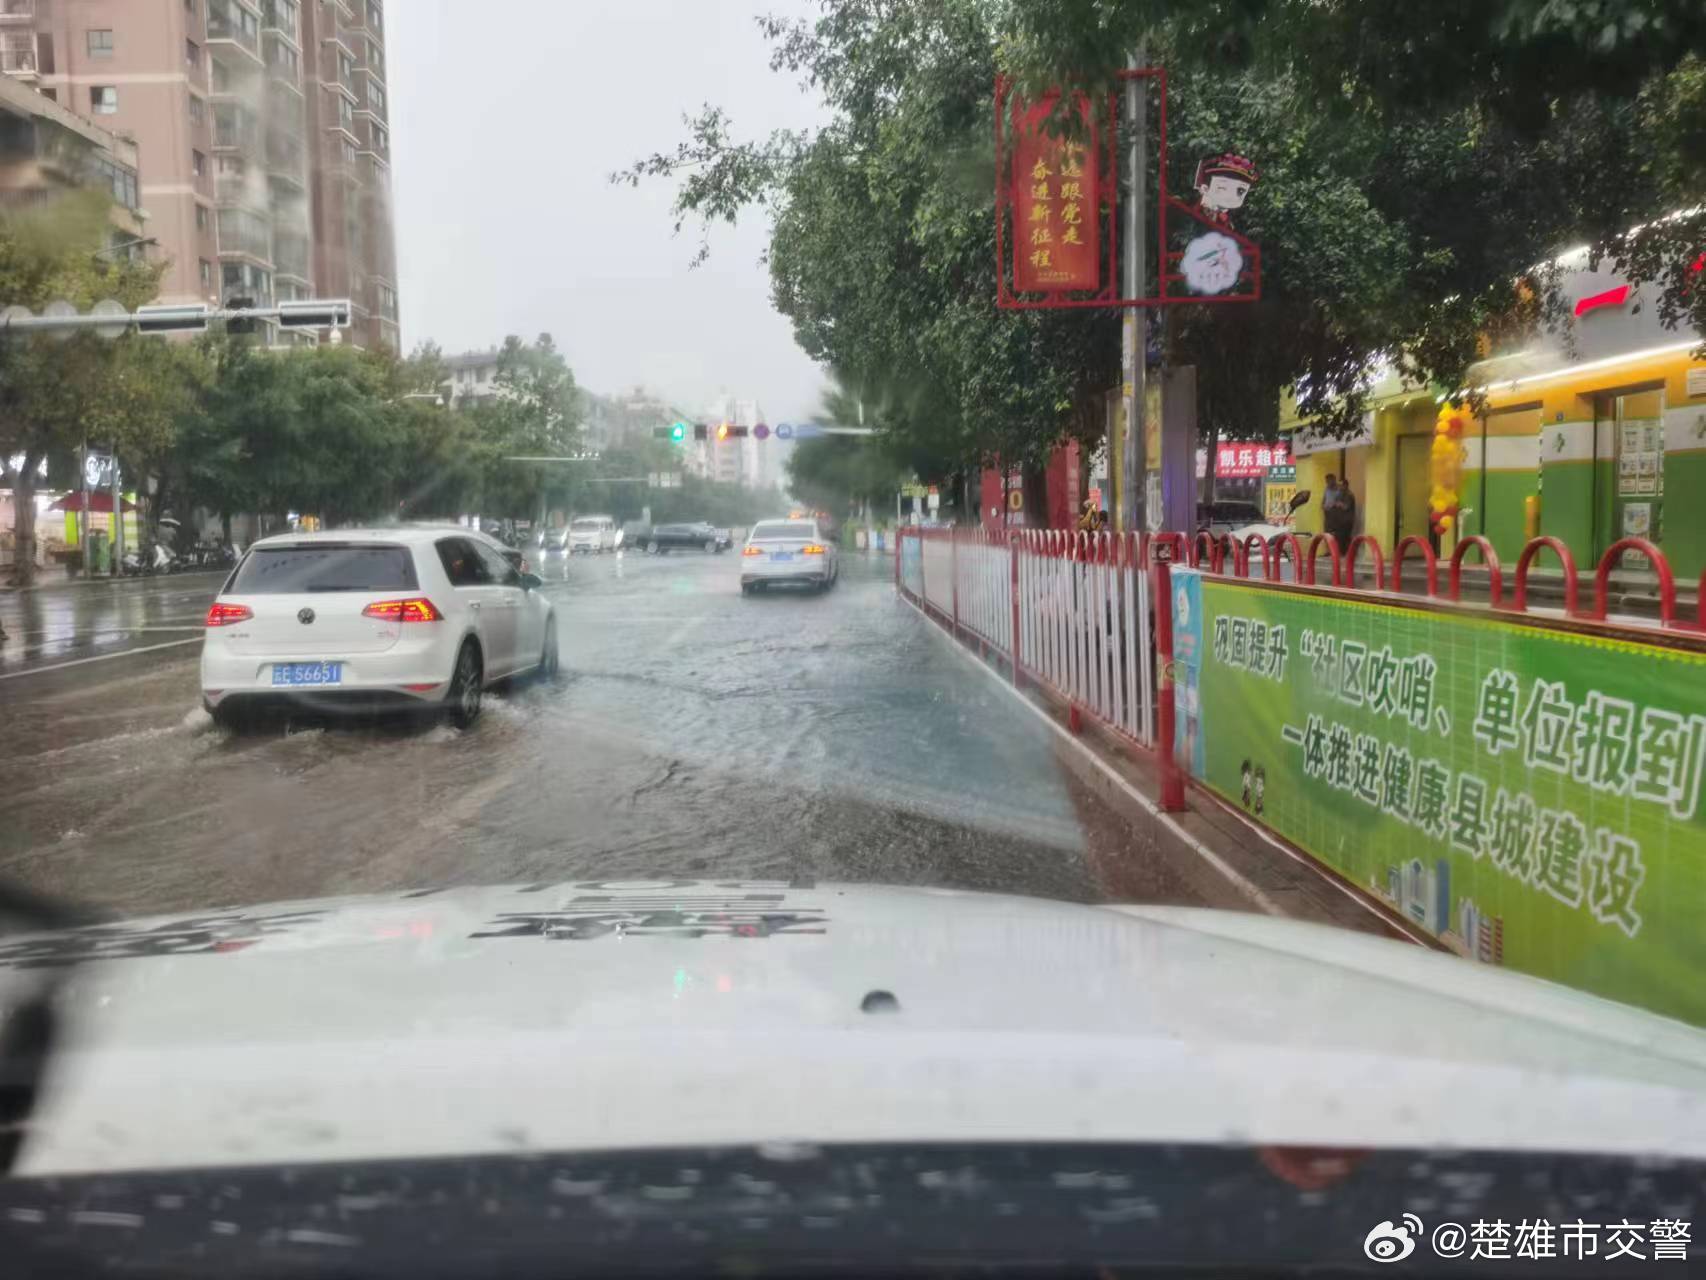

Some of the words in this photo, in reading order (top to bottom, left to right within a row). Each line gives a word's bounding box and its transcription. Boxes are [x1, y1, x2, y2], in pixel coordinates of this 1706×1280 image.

[1029, 157, 1052, 268] 奋进新征程
[1282, 714, 1644, 938] 一体推进健康县城建设
